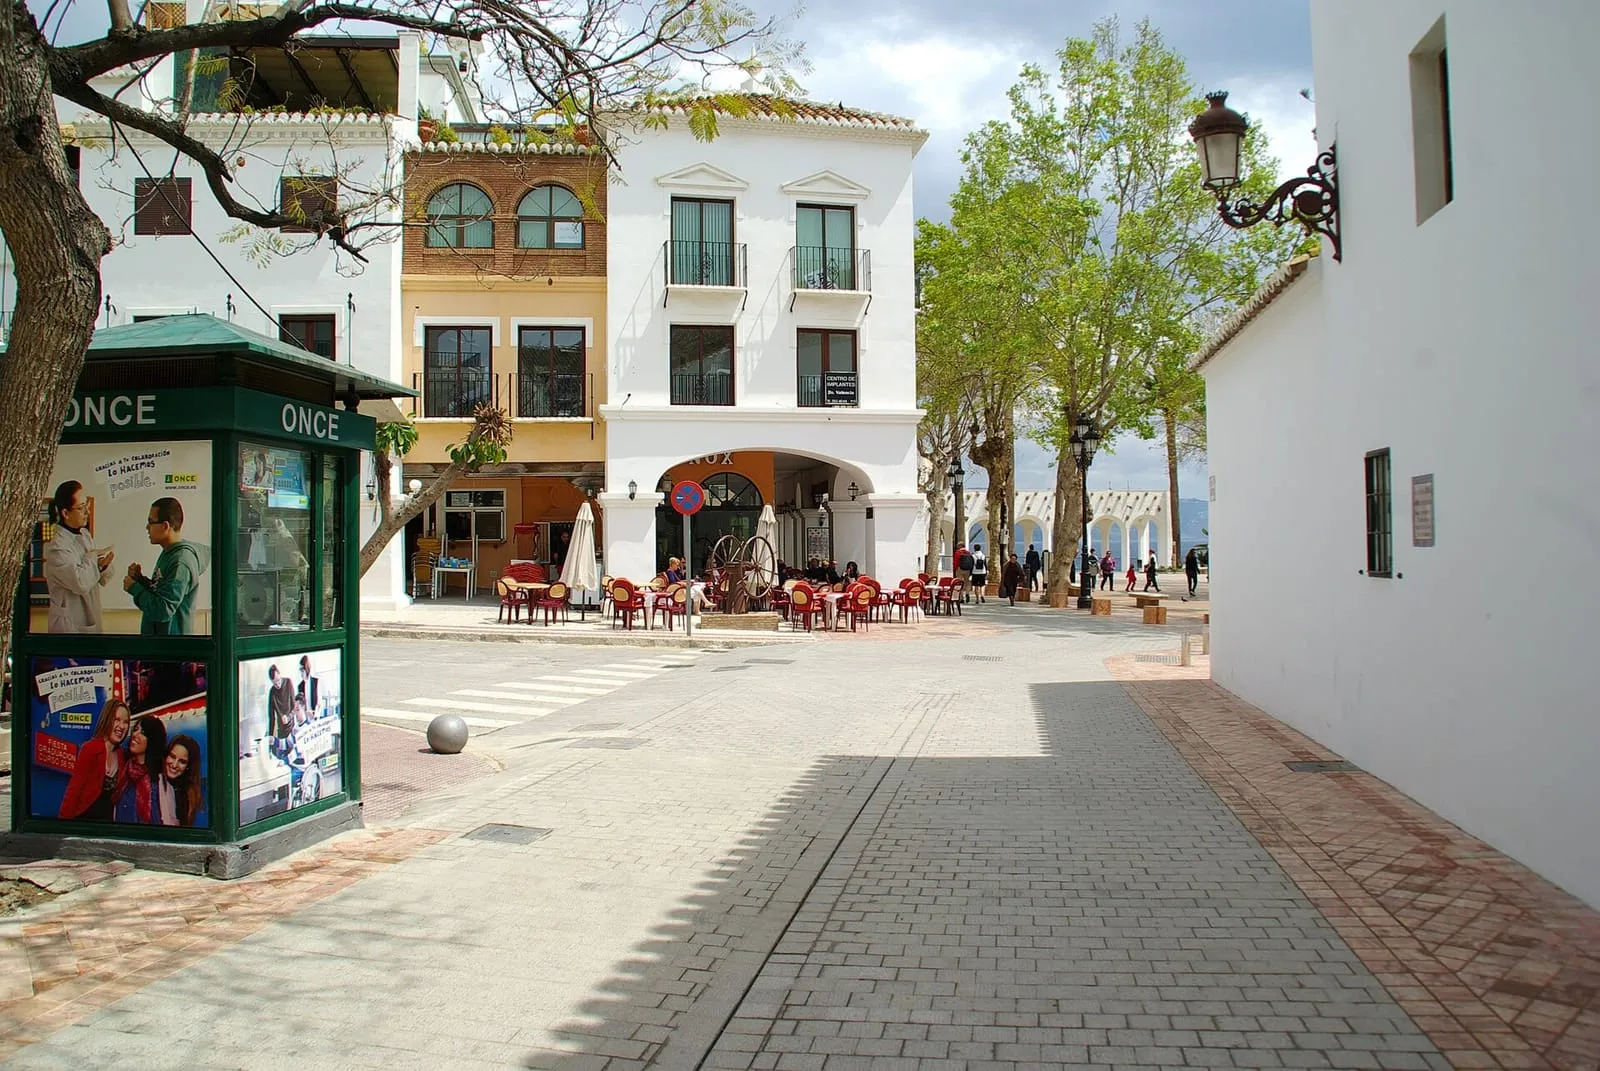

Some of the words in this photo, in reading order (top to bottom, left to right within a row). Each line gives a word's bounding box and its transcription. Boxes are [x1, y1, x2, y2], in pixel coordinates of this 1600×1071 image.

[282, 403, 340, 441] ONCE
[688, 451, 734, 465] OX
[94, 460, 116, 472] GRACIAS
[120, 460, 156, 475] HACEMOS
[173, 474, 197, 482] ONCE
[60, 676, 95, 688] HACEMOS
[68, 714, 90, 722] ONCE
